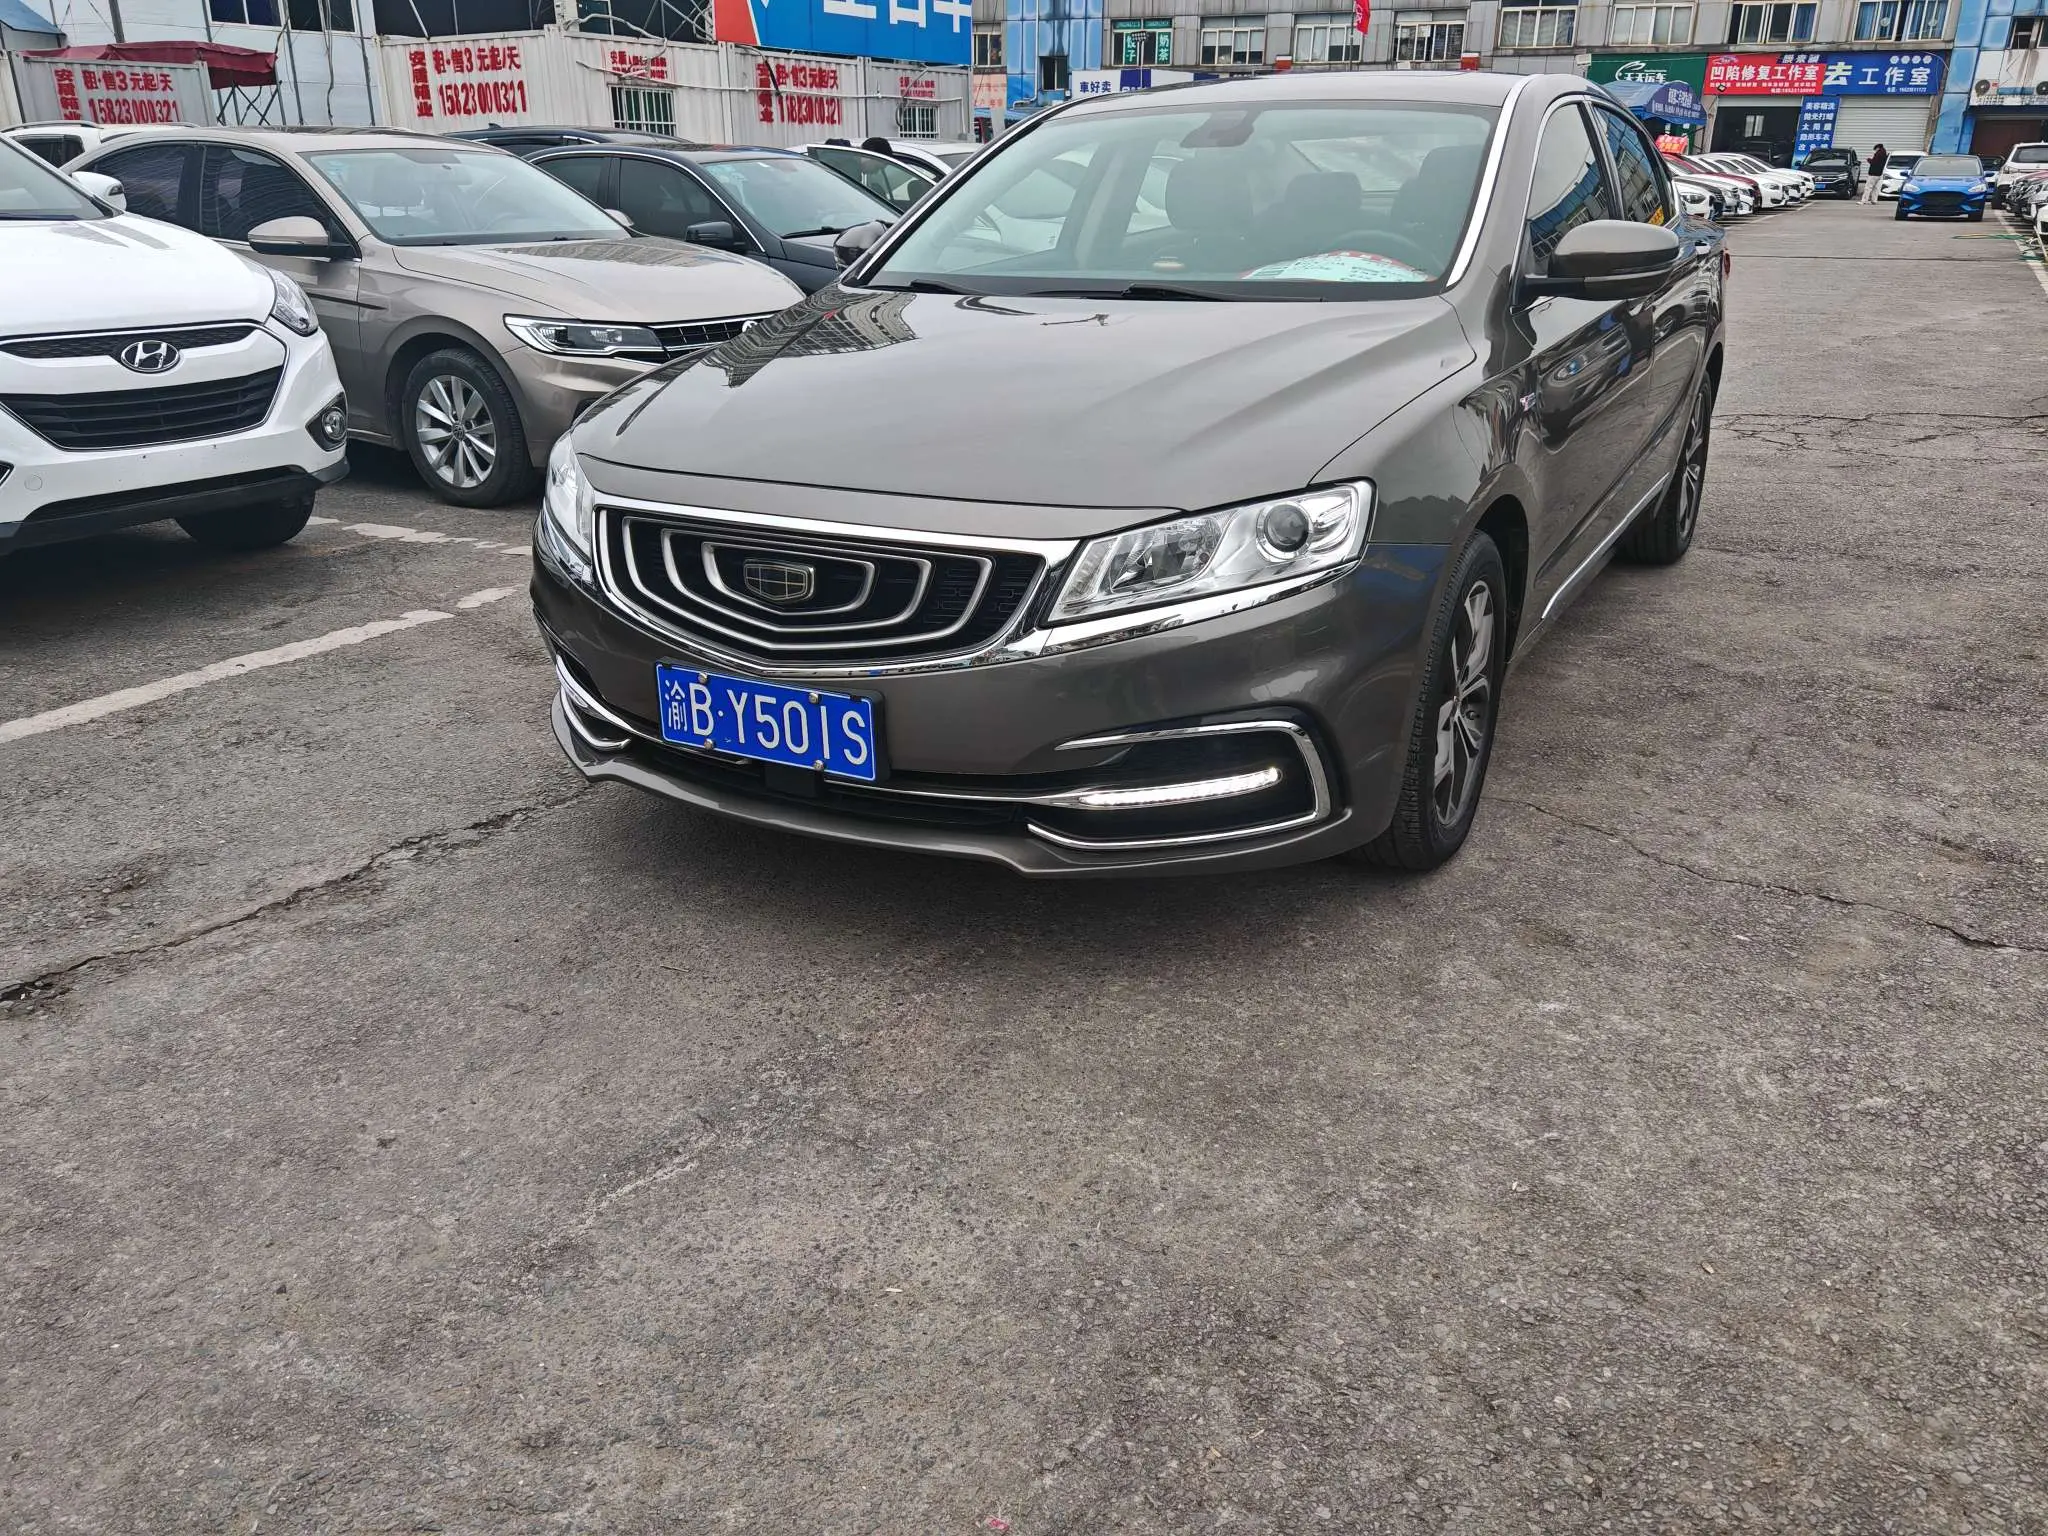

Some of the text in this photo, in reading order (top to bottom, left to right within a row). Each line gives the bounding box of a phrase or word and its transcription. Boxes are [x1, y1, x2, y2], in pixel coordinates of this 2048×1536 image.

[1710, 65, 1820, 81] 凹陷修复工作室
[1079, 80, 1112, 93] 車好卖
[438, 80, 527, 116] 15823000321
[88, 98, 180, 124] 15823000321
